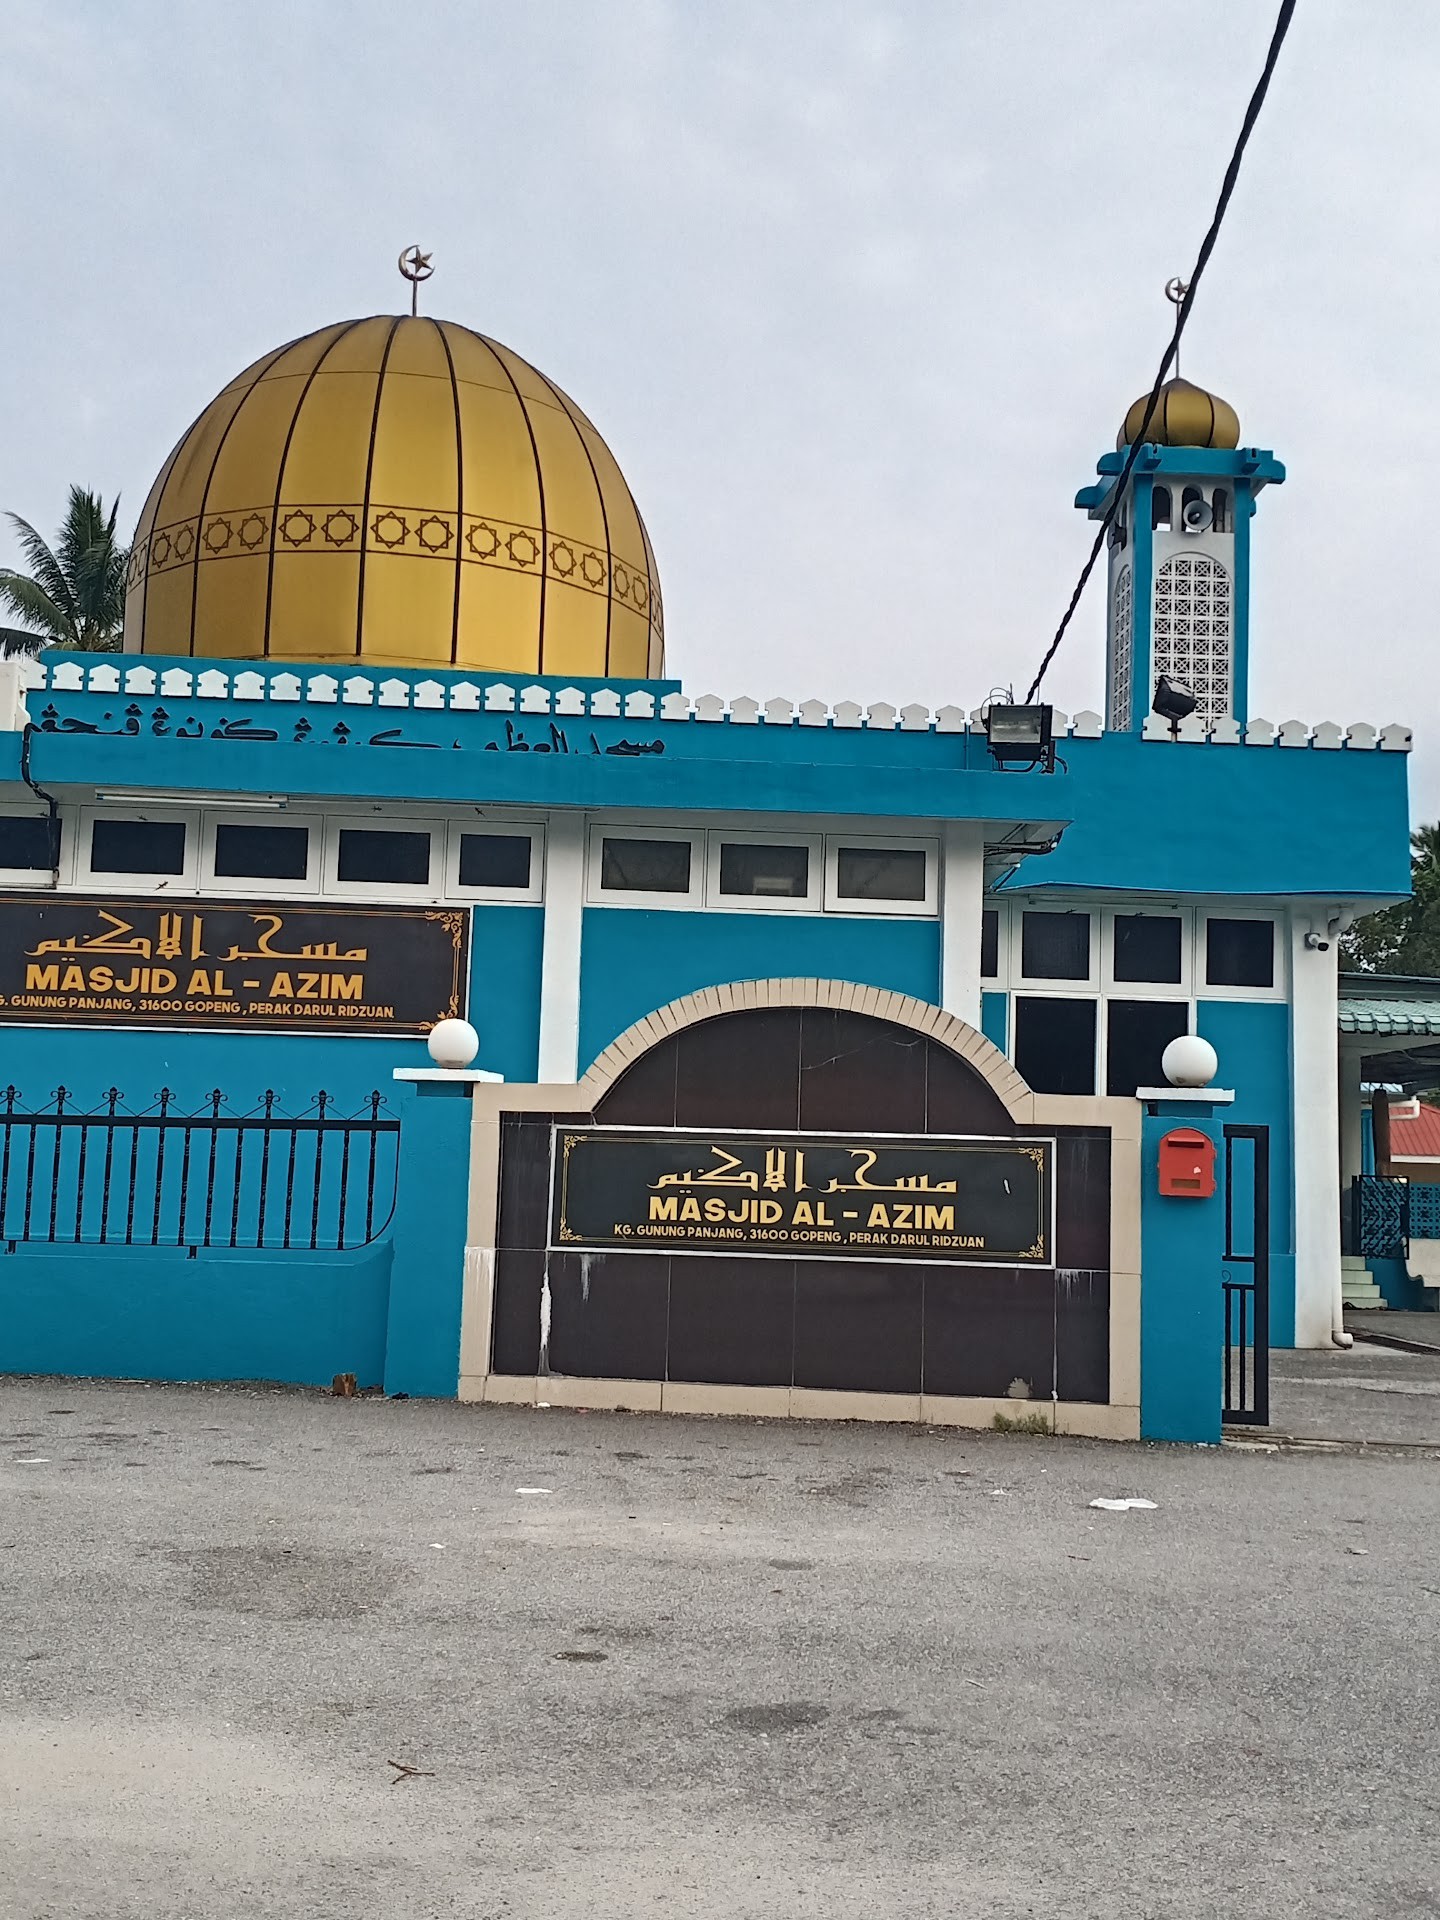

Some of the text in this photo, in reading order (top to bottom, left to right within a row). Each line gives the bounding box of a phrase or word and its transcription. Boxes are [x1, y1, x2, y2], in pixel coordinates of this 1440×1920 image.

[26, 963, 178, 994] MASJID
[187, 969, 234, 997] AL
[269, 971, 364, 1000] AZIM
[11, 995, 67, 1009] GUNUNG
[69, 997, 137, 1013] PANJANG,
[139, 1000, 183, 1013] 31600
[249, 1003, 292, 1016] PERAK
[294, 1004, 336, 1017] DARUL
[649, 1196, 783, 1225] MASJID
[792, 1200, 835, 1227] AL
[867, 1203, 955, 1231] AZIM
[614, 1223, 635, 1236] KG.
[637, 1224, 686, 1238] GUNUNG
[688, 1226, 747, 1241] PANJANG,
[749, 1228, 788, 1241] 31600
[850, 1231, 889, 1244] PERAK
[891, 1233, 931, 1246] DARUL
[932, 1235, 985, 1248] RIDZUAN
